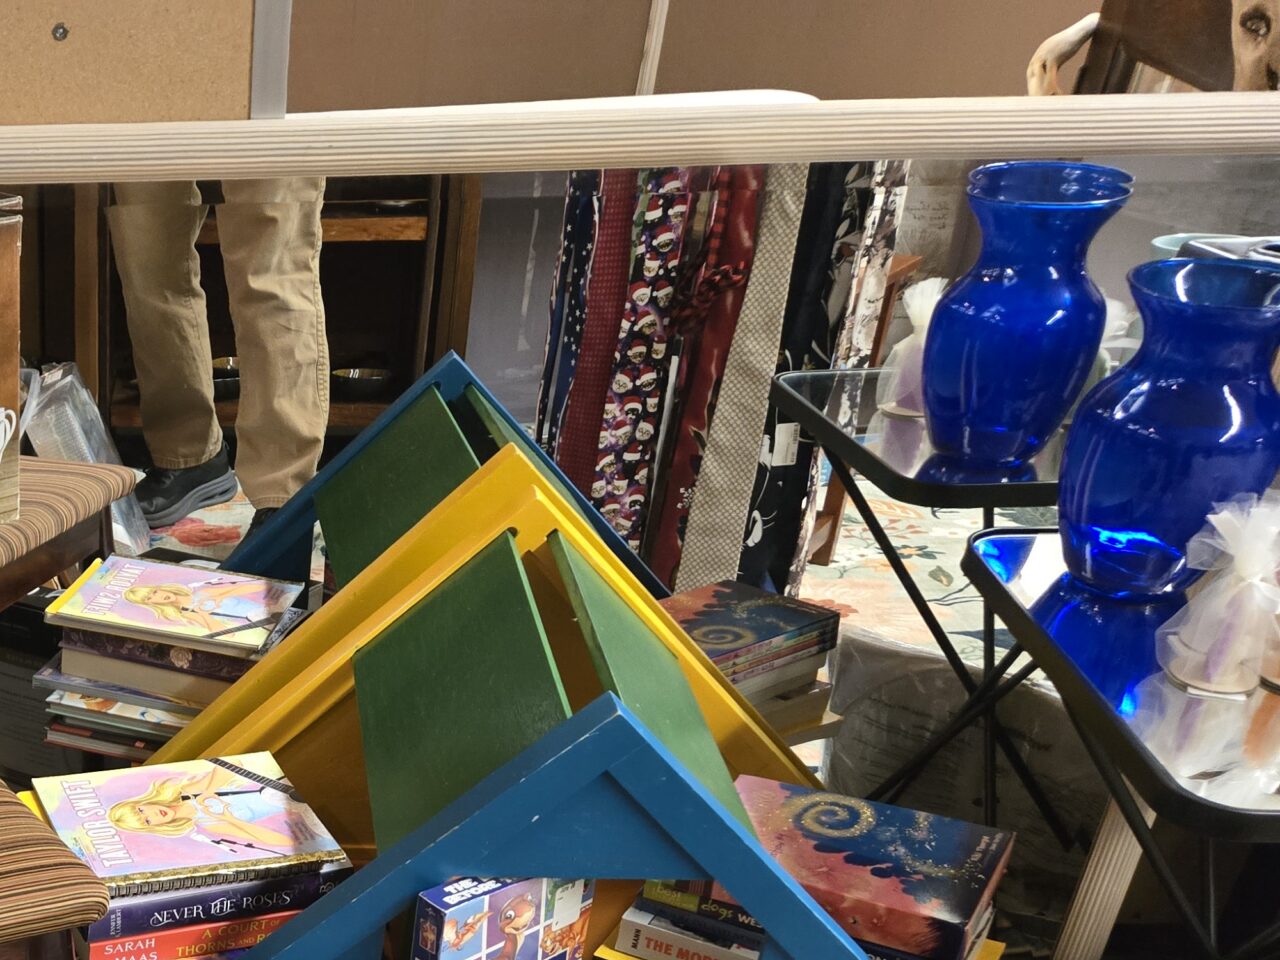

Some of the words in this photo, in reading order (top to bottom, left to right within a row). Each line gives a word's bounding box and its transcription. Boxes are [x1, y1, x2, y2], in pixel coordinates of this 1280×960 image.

[61, 780, 106, 822] SWIFT
[82, 820, 134, 868] TAYLOR
[443, 880, 502, 904] BEFORE
[150, 905, 205, 927] NEVER
[210, 897, 236, 916] THE
[243, 891, 291, 909] ROSES
[701, 897, 734, 919] dogs
[202, 929, 212, 939] A
[218, 920, 269, 936] COURT
[632, 929, 641, 950] MANN
[104, 938, 156, 955] SARAH
[176, 938, 235, 958] THORNS
[239, 937, 255, 945] AND
[645, 937, 673, 956] THE
